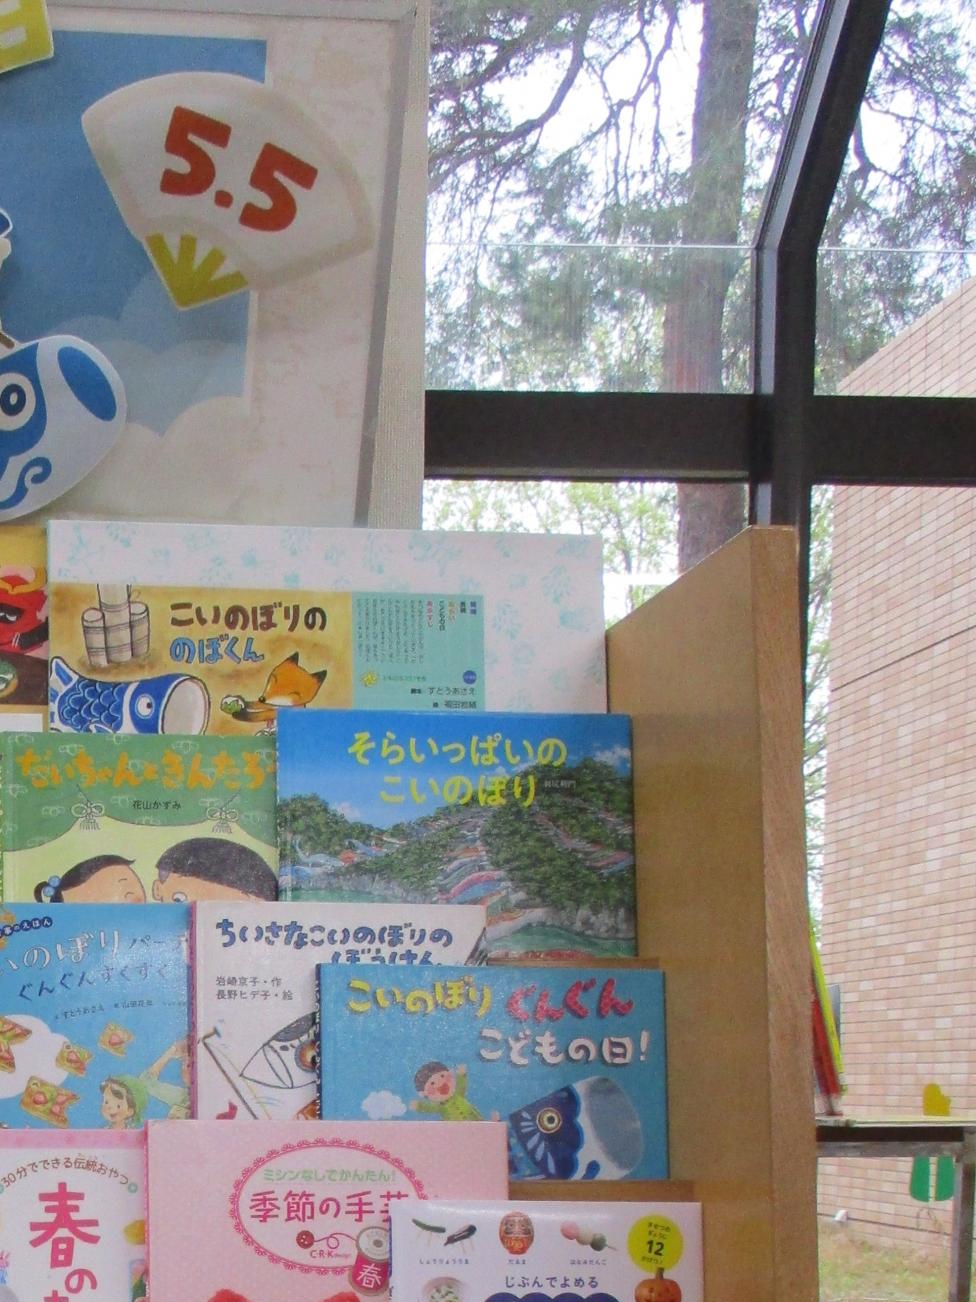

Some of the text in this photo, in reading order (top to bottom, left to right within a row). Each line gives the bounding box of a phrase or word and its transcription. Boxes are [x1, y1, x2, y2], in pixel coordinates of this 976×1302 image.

[160, 106, 318, 231] 5.5
[170, 602, 327, 632] こいのぼりの
[170, 634, 265, 664] のぼくん
[348, 731, 568, 767] そらいっぱいの
[132, 800, 182, 811] 花山かずみ
[379, 774, 536, 808] こいのぼり
[216, 918, 453, 949] ちいさなこいのぼりの
[216, 989, 293, 1001] 長野ヒデ子・絵
[347, 974, 634, 1023] こいのぼり ぐんぐん
[479, 1027, 650, 1067] こどもの日!
[0, 1156, 129, 1188] 30分でできる伝統おやつ
[263, 1168, 396, 1183] ミシンなしでかんたん!
[646, 1239, 665, 1257] 12
[356, 1263, 382, 1288] 春
[505, 1276, 599, 1289] じぶんでよめる
